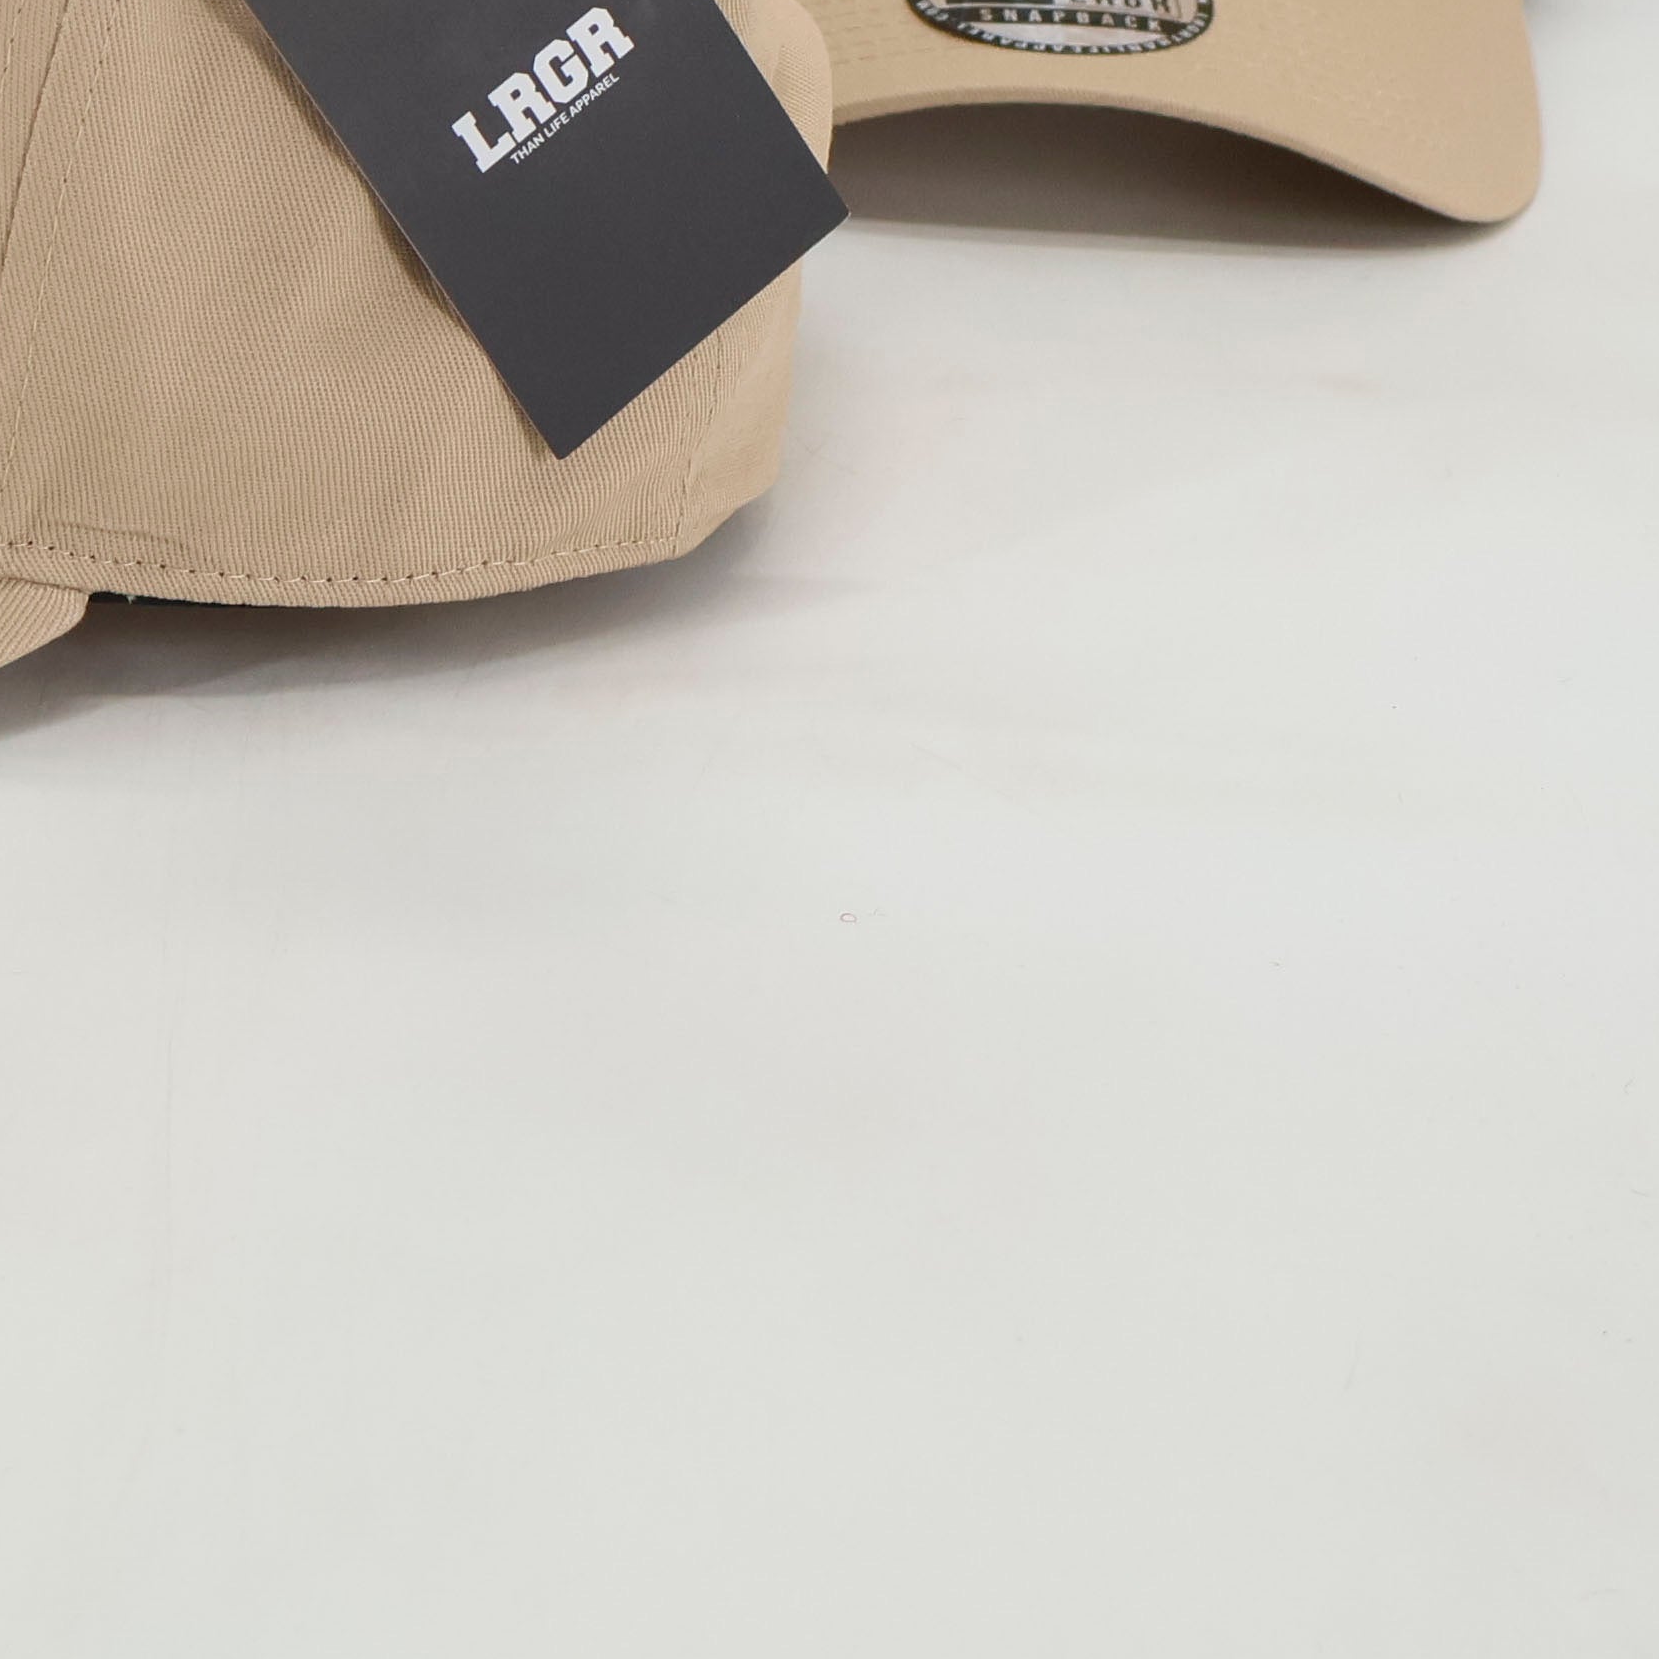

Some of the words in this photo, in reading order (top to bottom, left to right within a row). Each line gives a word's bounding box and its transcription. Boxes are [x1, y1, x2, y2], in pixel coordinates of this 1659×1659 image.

[451, 6, 635, 174] LRGR
[510, 132, 545, 164] THAN
[543, 113, 571, 138] LIFE
[569, 72, 620, 118] APPAREL
